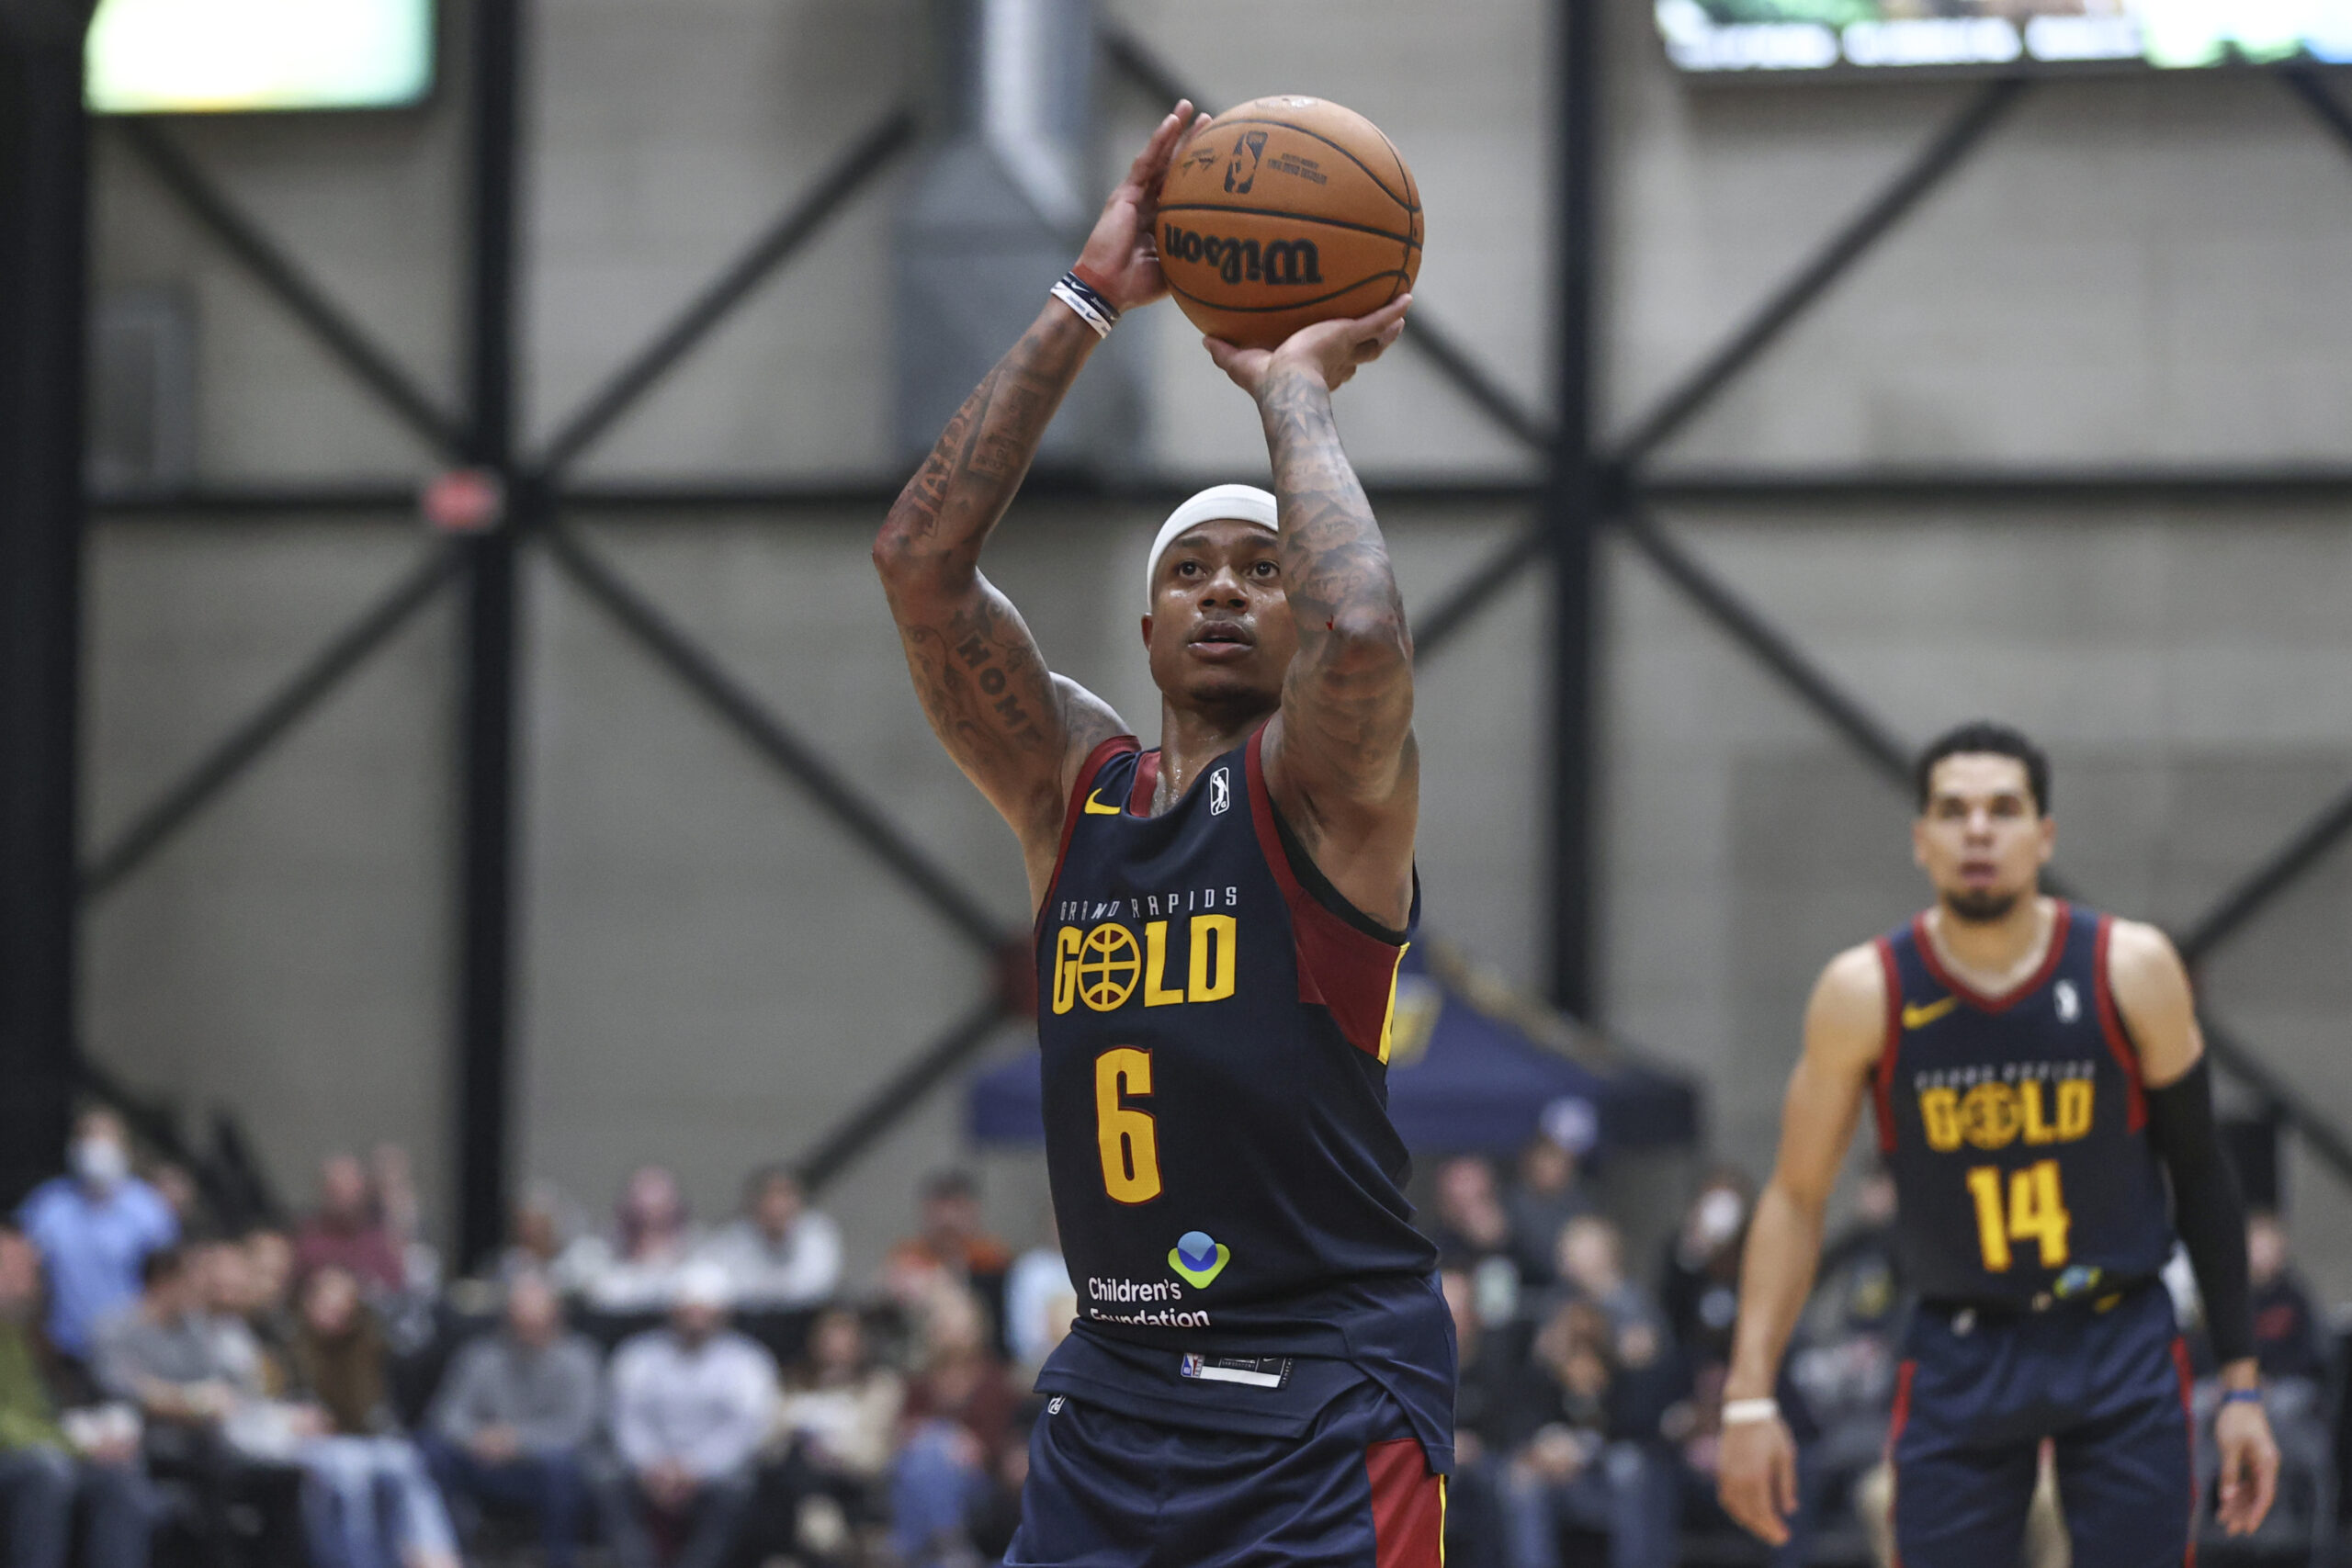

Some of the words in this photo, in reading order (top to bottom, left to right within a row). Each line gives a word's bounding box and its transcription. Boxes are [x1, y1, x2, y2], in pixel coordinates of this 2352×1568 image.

[1165, 223, 1324, 286] Wilson
[1060, 901, 1120, 921] GRAND
[1131, 886, 1238, 918] RAPIDS
[1053, 914, 1237, 1015] GOLD
[1094, 1044, 1163, 1206] 6
[1919, 1077, 2095, 1152] GOLD
[1966, 1158, 2071, 1273] 14
[1089, 1276, 1182, 1303] Children's
